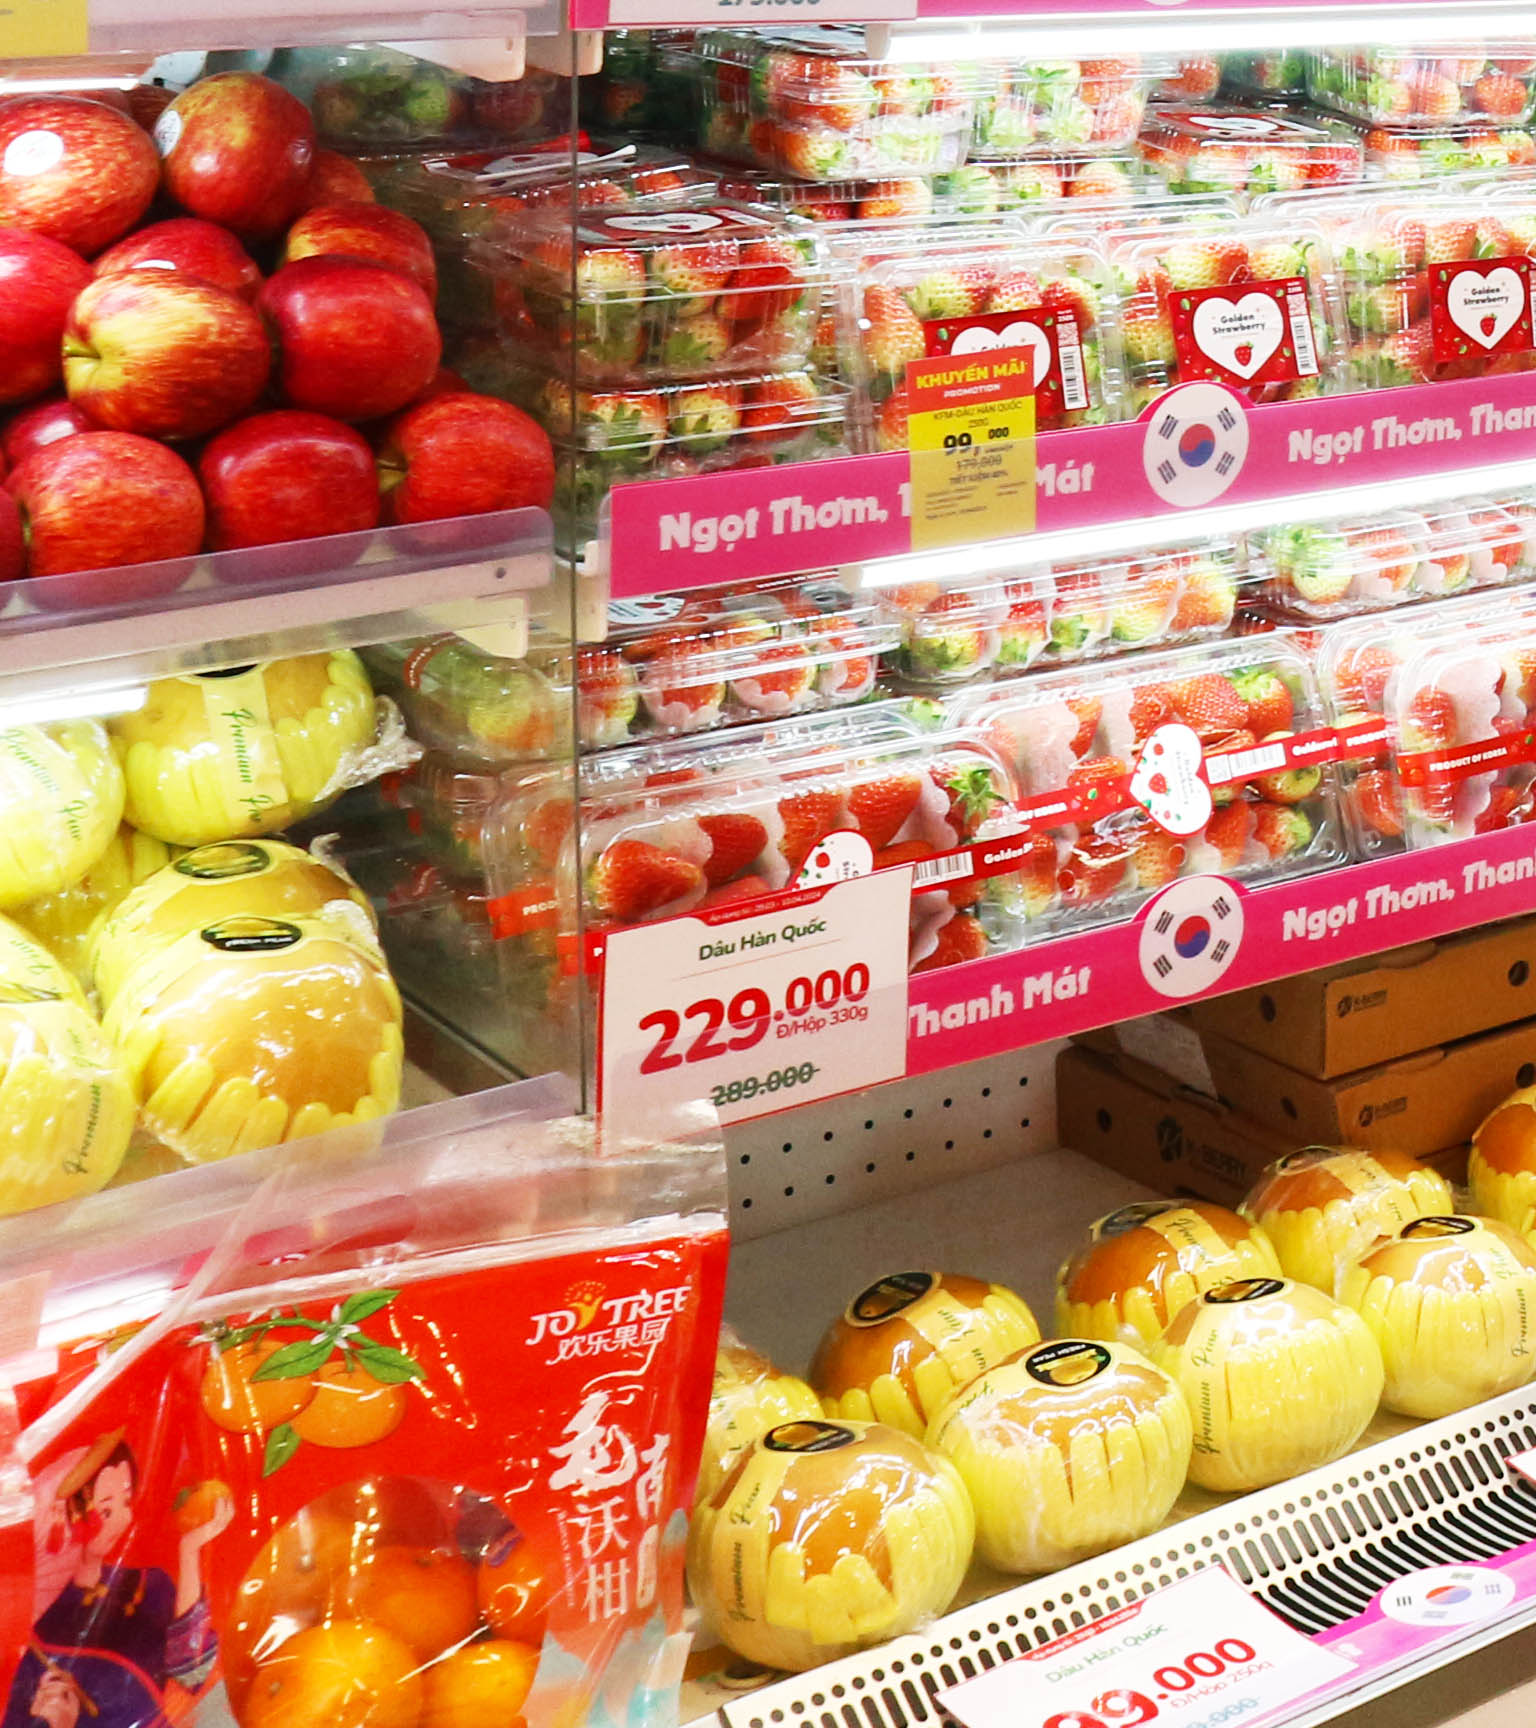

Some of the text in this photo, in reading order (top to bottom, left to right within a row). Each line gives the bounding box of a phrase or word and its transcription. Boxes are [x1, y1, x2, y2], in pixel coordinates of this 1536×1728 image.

[1462, 293, 1510, 306] Strawberry
[1470, 285, 1502, 297] Golden
[1212, 320, 1266, 335] Strawberry
[1219, 312, 1256, 325] Golden
[916, 358, 1027, 389] KHUYẾN MÃI
[1429, 747, 1508, 772] PRODUCT OF KOREA
[698, 916, 827, 962] Dâu Hàn Quốc
[639, 962, 871, 1076] 229.000
[775, 1006, 868, 1041] Đ/Hộp 330g
[711, 1062, 820, 1108] 289.000
[602, 1285, 692, 1326] TREE
